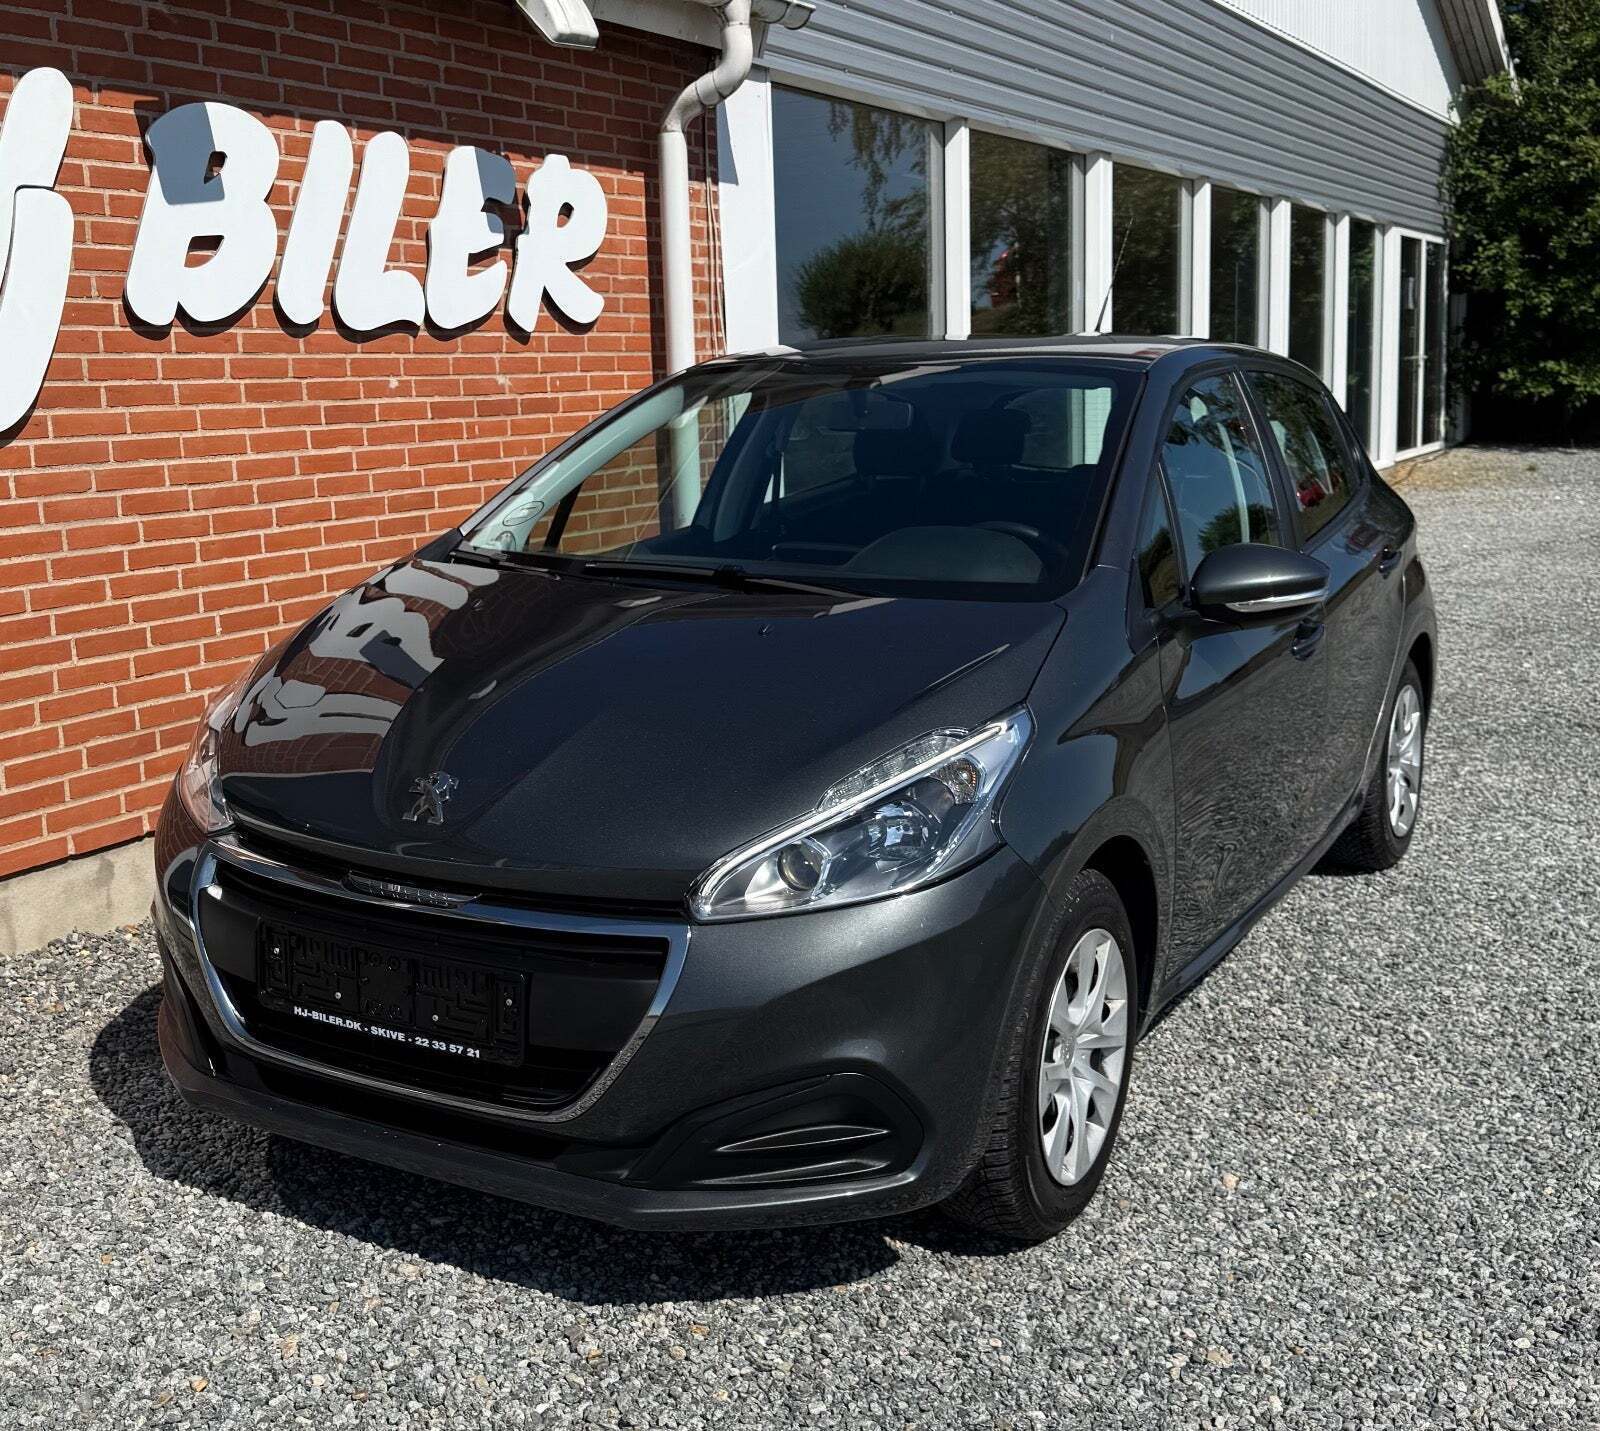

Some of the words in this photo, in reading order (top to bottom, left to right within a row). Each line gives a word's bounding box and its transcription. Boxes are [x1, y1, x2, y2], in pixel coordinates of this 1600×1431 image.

[124, 101, 608, 333] BILER
[294, 1006, 362, 1031] HJ-BILER.DK
[370, 1026, 406, 1042] SKIVE
[415, 1036, 430, 1048] 22
[432, 1040, 447, 1051] 33
[449, 1044, 464, 1055] 57
[466, 1047, 481, 1058] 21
